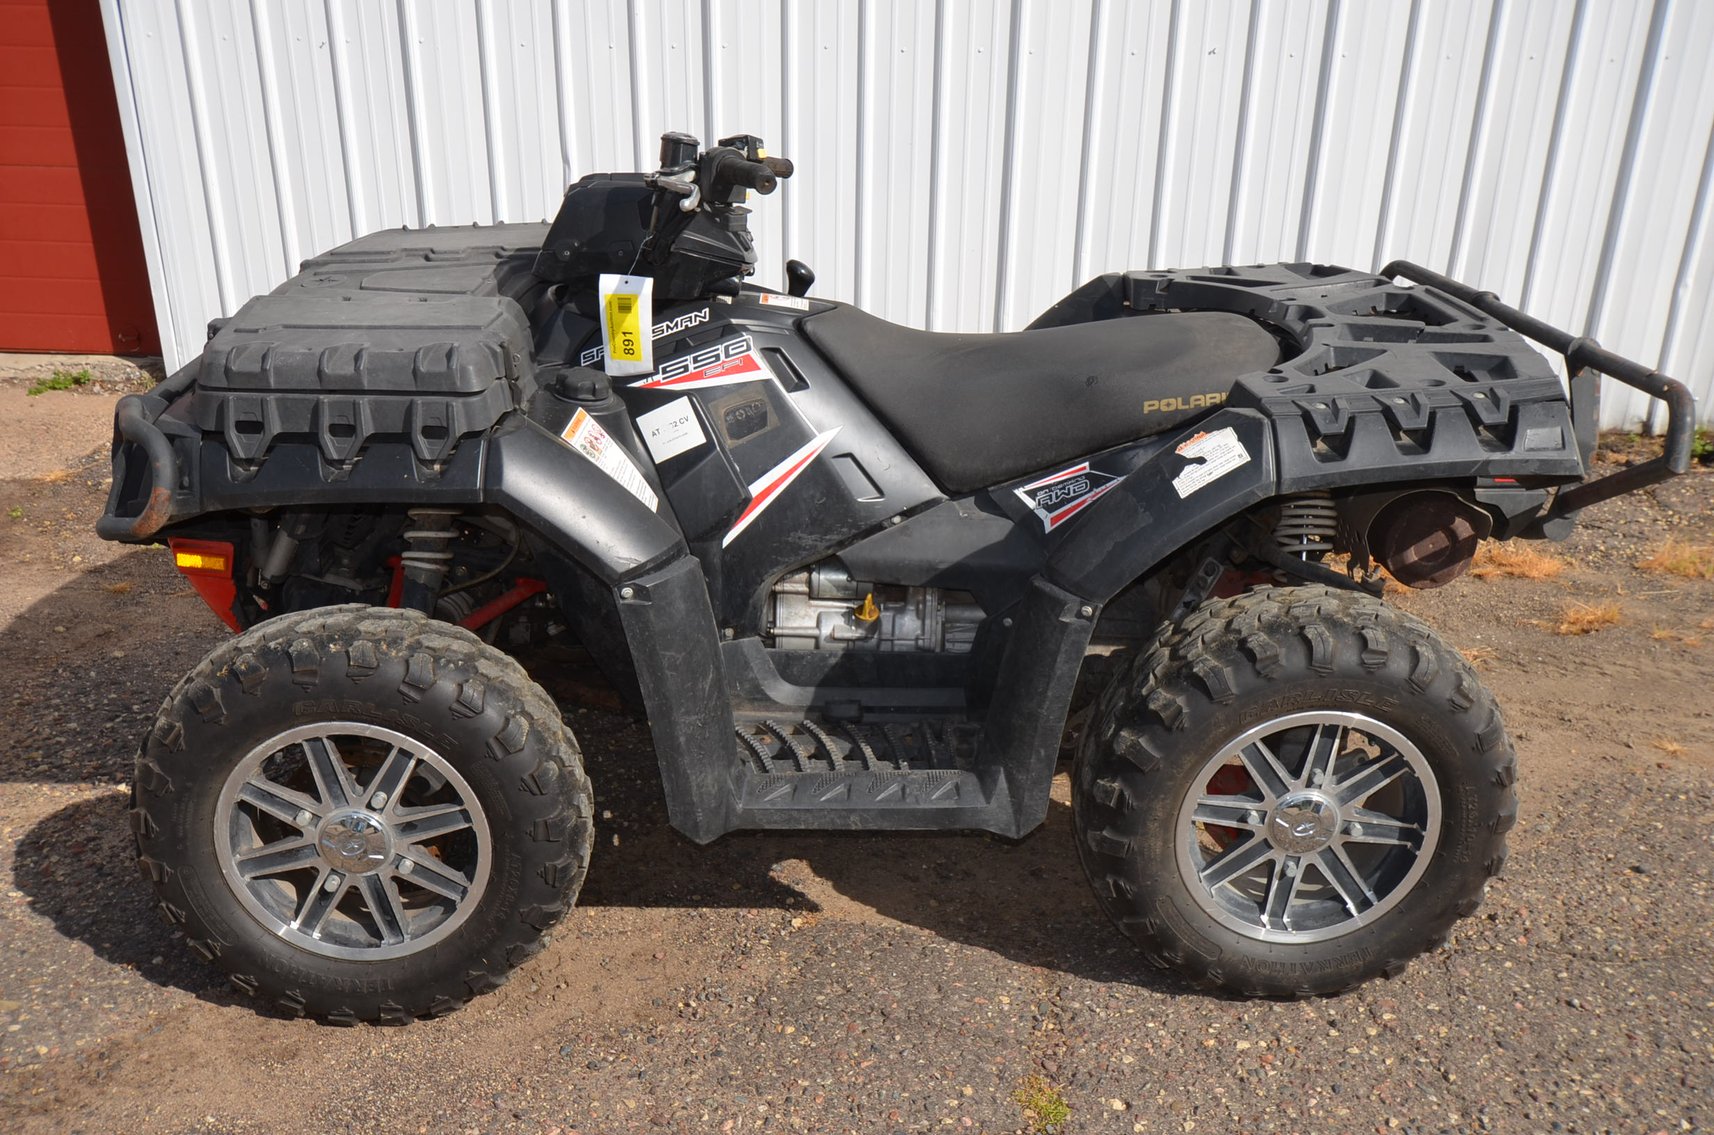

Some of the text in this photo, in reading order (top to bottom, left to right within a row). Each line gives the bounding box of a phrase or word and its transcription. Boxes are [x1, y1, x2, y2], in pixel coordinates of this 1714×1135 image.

[581, 307, 710, 366] SPSMAN
[623, 330, 636, 356] 891
[659, 335, 753, 383] 550
[703, 358, 744, 379] EFI
[1143, 391, 1228, 414] POLARI
[1035, 479, 1091, 509] AWD
